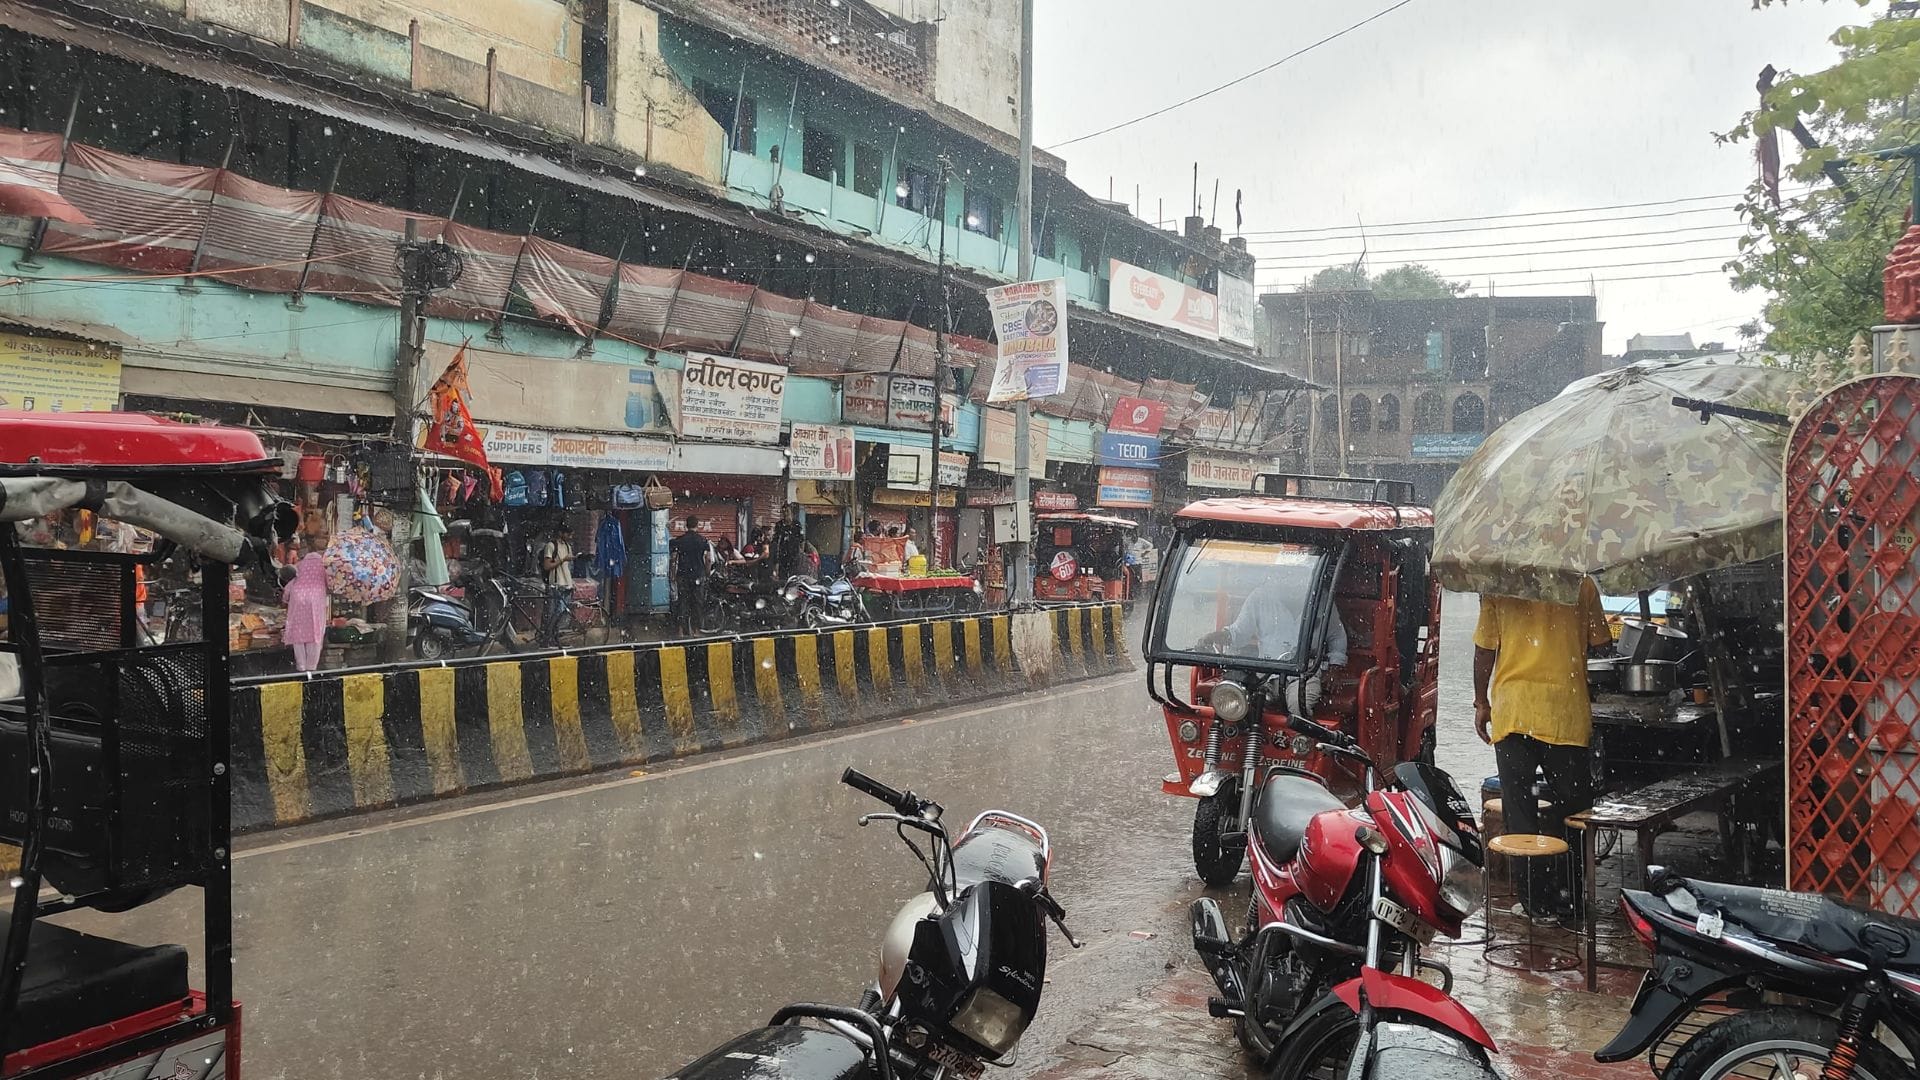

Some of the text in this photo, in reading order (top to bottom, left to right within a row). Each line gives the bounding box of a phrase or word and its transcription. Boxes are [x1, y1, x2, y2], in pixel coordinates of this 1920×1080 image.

[1002, 320, 1022, 333] CBSE
[495, 431, 526, 441] SHIV
[487, 441, 543, 454] SUPPLIERS
[551, 436, 608, 456] आकाशदीप
[1117, 443, 1147, 459] TECNO
[1212, 464, 1240, 482] जनरल
[1377, 902, 1392, 919] UP
